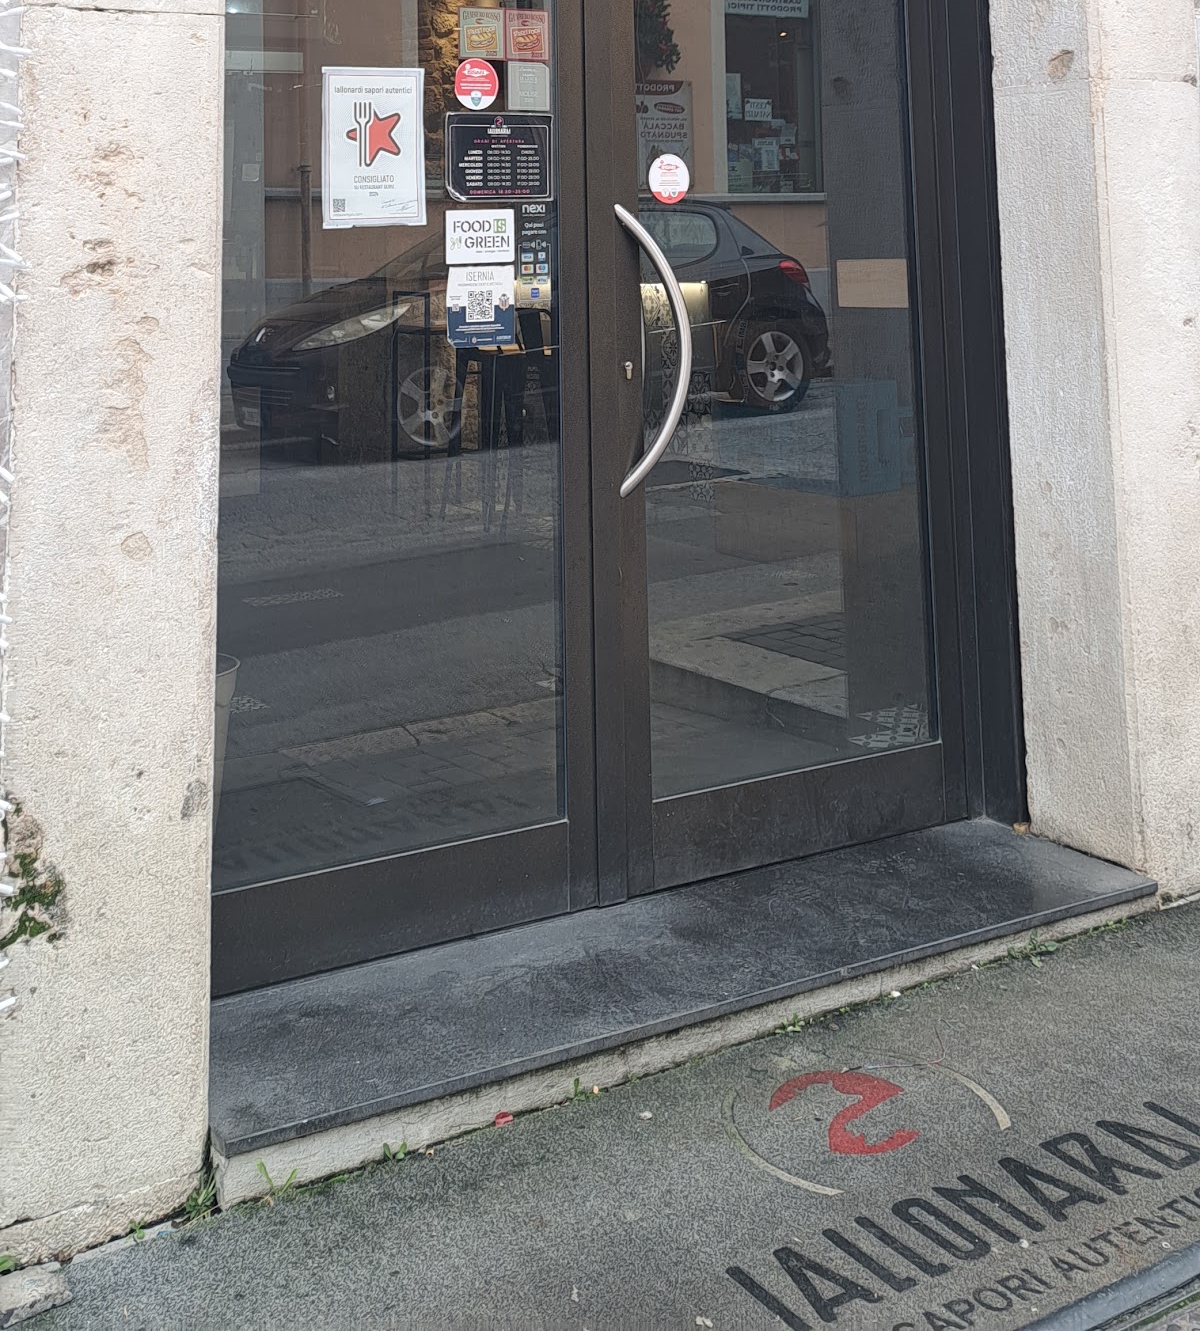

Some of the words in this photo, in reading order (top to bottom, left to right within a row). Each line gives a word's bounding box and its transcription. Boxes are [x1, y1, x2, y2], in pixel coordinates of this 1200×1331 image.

[334, 86, 363, 94] Iallonardi
[365, 86, 384, 95] sapori
[385, 86, 412, 94] autentici
[354, 175, 394, 183] CONSIGLIATO
[522, 204, 545, 213] nexi
[453, 220, 491, 233] FOOD
[465, 235, 510, 248] GREEN
[466, 271, 494, 282] ISERNIA
[1050, 1187, 1200, 1281] AUTENTI
